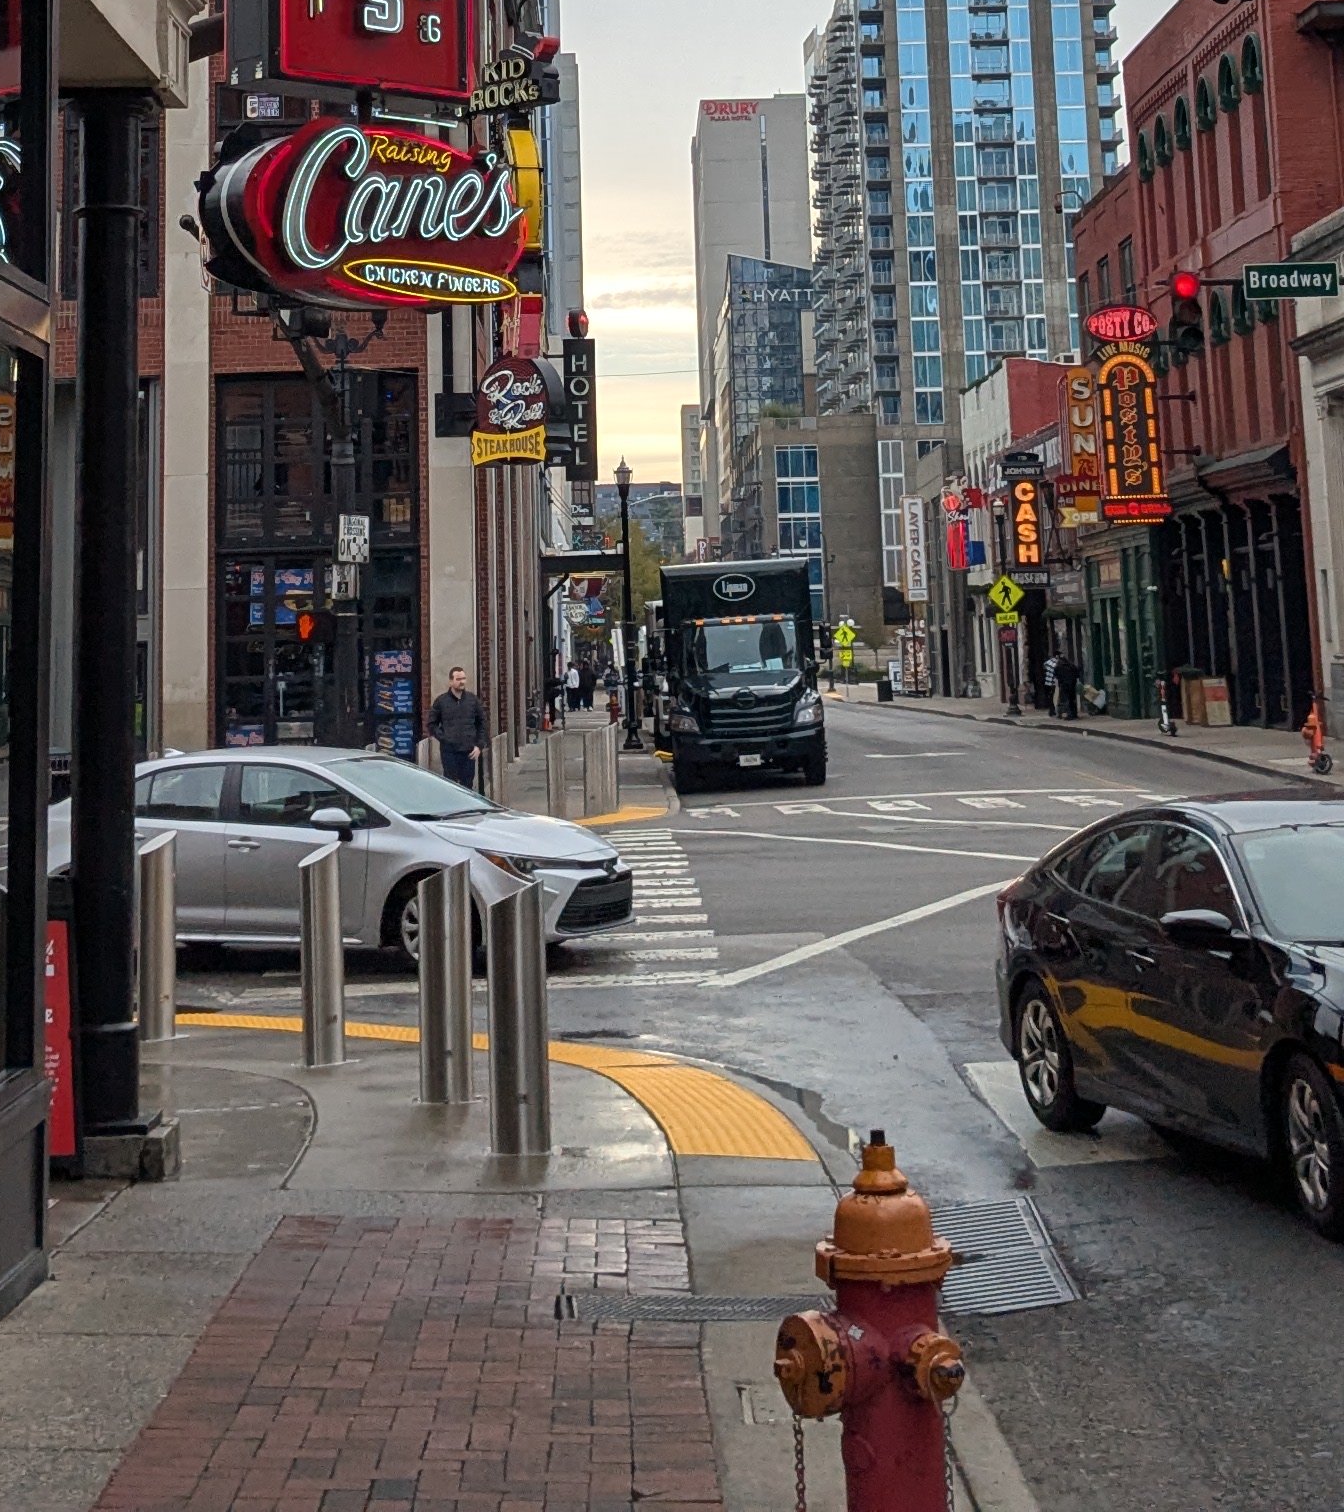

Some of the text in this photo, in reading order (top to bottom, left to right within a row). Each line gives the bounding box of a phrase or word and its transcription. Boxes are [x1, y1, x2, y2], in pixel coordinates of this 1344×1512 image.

[483, 57, 526, 83] KID
[703, 100, 759, 116] DRURY
[369, 134, 453, 173] Raising
[282, 123, 526, 270] Cane's
[365, 263, 501, 295] CHICKEN FINGERS
[1248, 268, 1334, 291] Broadway
[1090, 309, 1131, 338] POSTY
[1097, 341, 1151, 361] LIVE MUSIC
[481, 369, 544, 404] Rock
[500, 399, 545, 429] Roll
[569, 353, 590, 467] HOTEL
[1071, 378, 1097, 455] SUN
[476, 430, 541, 459] STEAKHOUSE
[1004, 466, 1042, 476] JOHNNY
[908, 501, 920, 547] LAYER
[1014, 482, 1040, 564] CASH
[340, 538, 352, 556] OK
[910, 548, 922, 588] CAKE
[1011, 571, 1048, 585] MUSEUM
